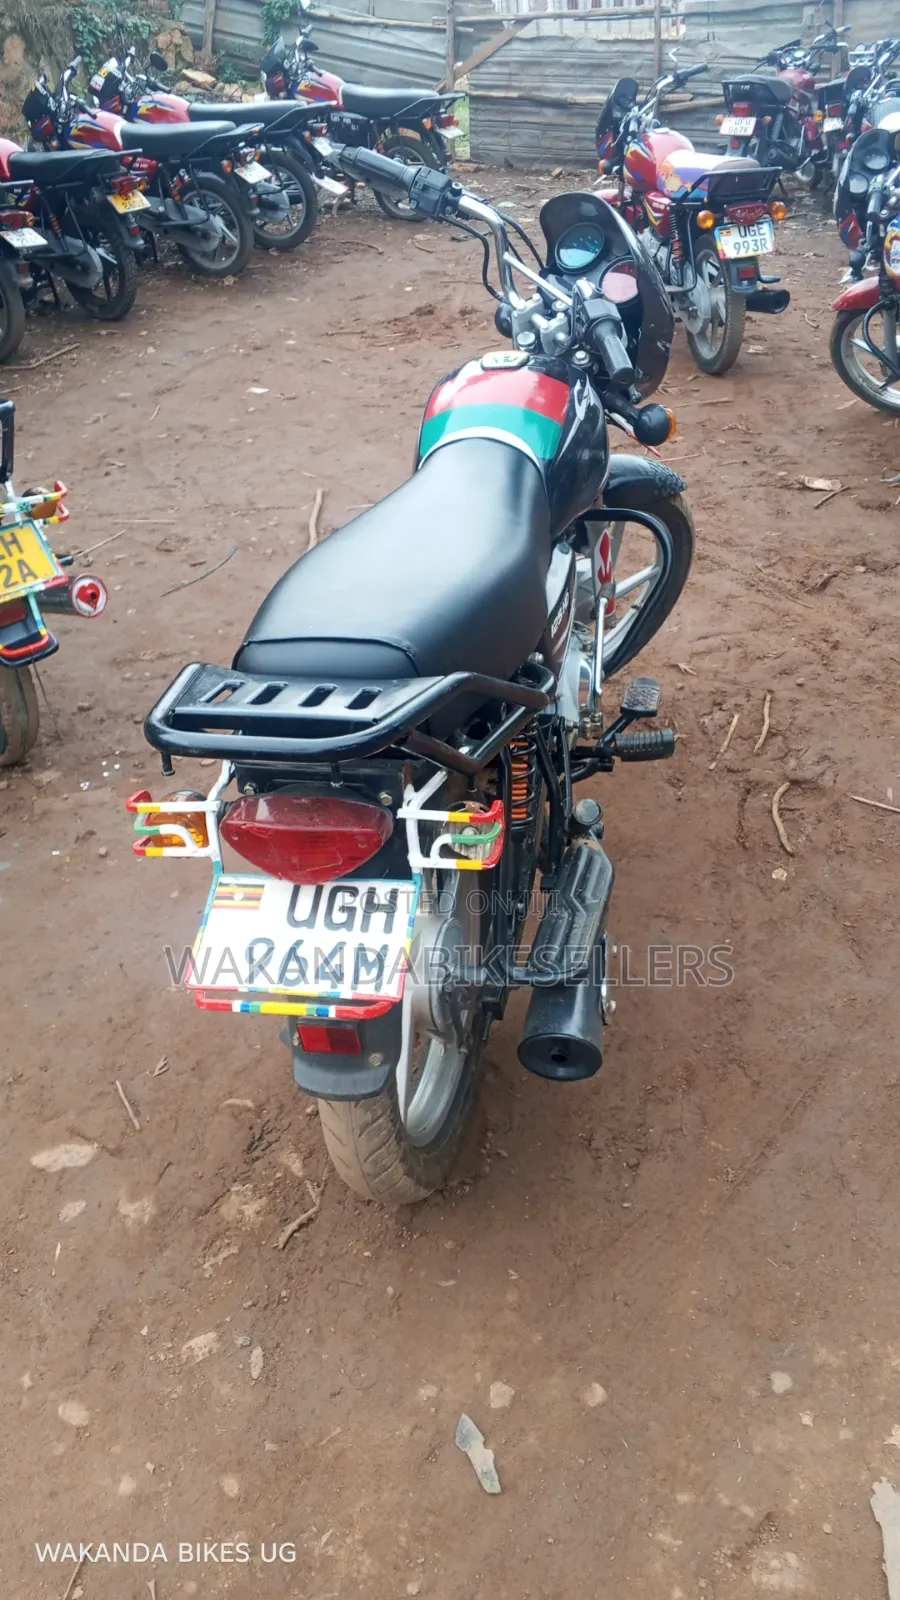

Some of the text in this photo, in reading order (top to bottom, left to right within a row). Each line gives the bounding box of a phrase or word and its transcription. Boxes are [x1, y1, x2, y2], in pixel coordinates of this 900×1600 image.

[737, 223, 766, 238] UGE
[733, 238, 769, 255] 993R
[0, 532, 24, 560] H
[0, 559, 38, 588] 2A
[286, 884, 399, 934] UGH
